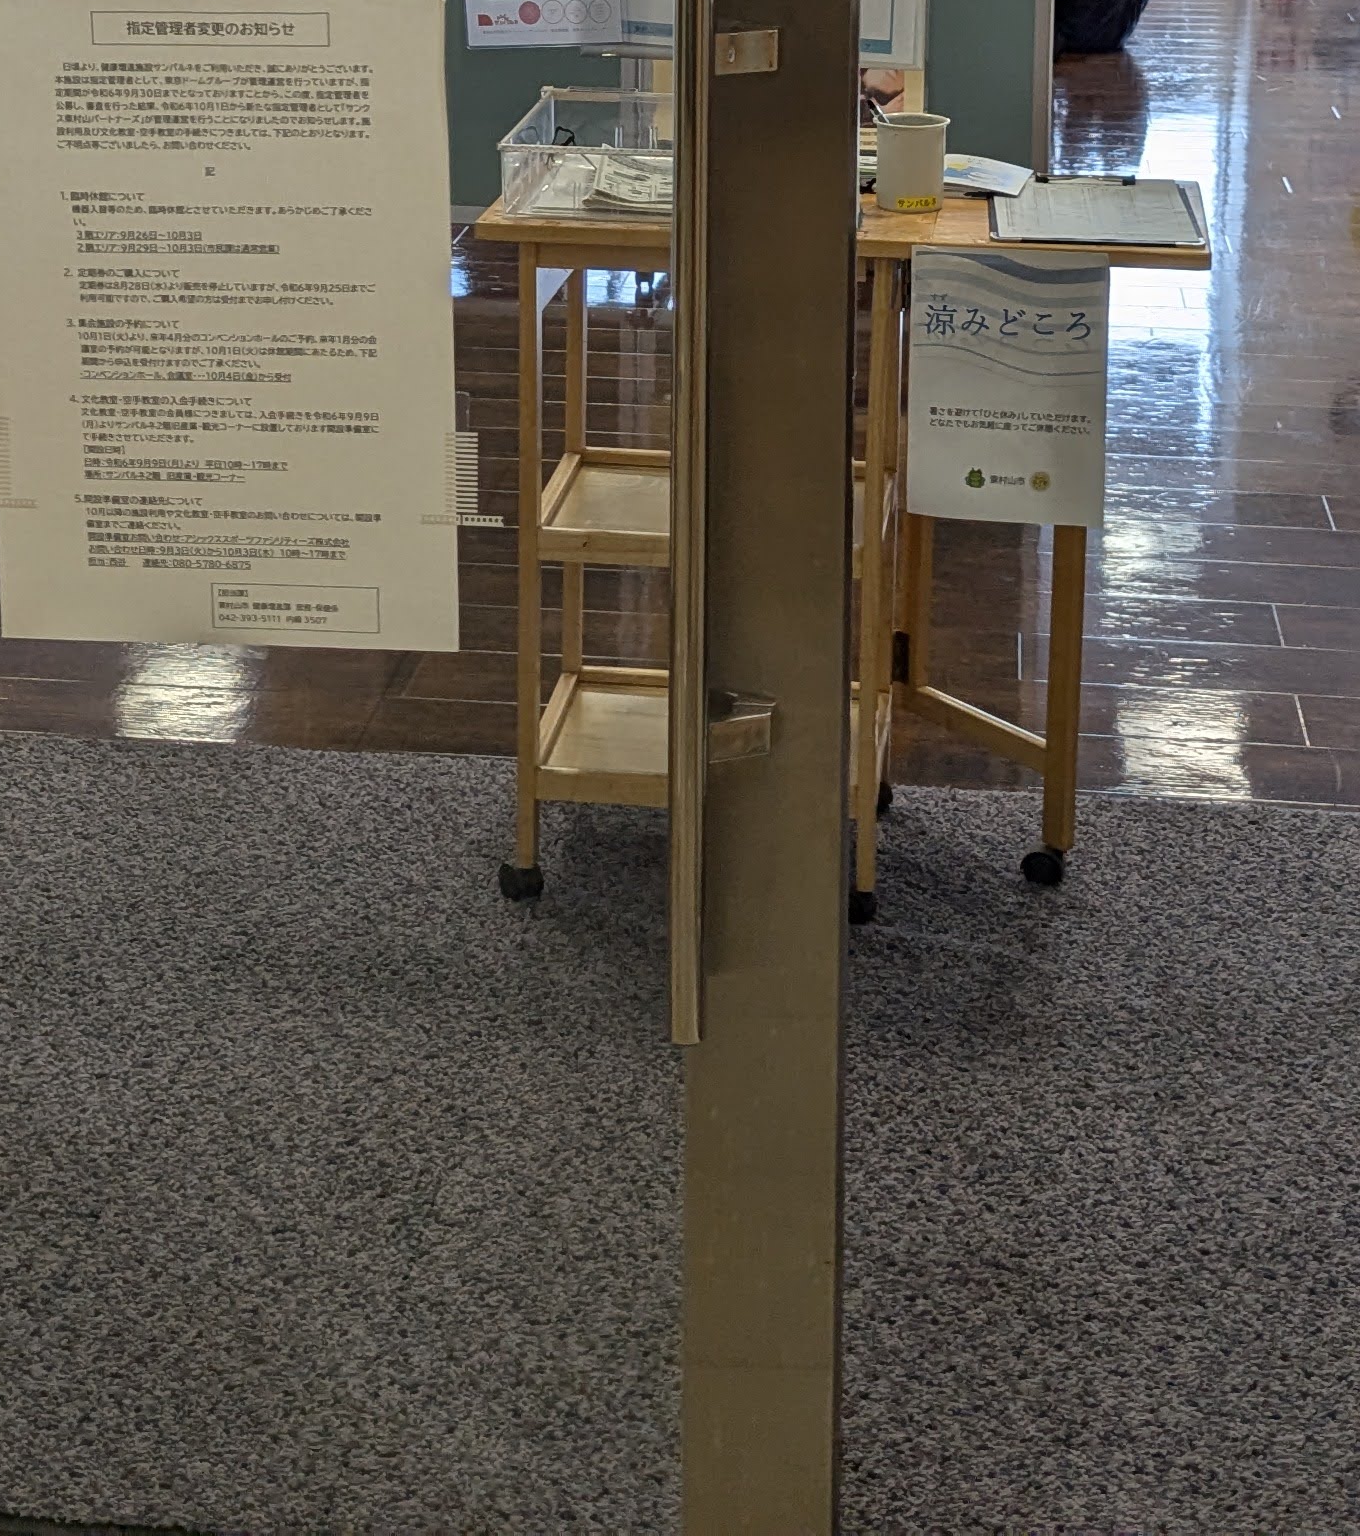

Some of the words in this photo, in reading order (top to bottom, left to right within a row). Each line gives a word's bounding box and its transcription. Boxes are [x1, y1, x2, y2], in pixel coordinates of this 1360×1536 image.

[126, 20, 296, 37] 指定管理者変更のお知らせ
[924, 304, 1091, 340] 涼みどころ
